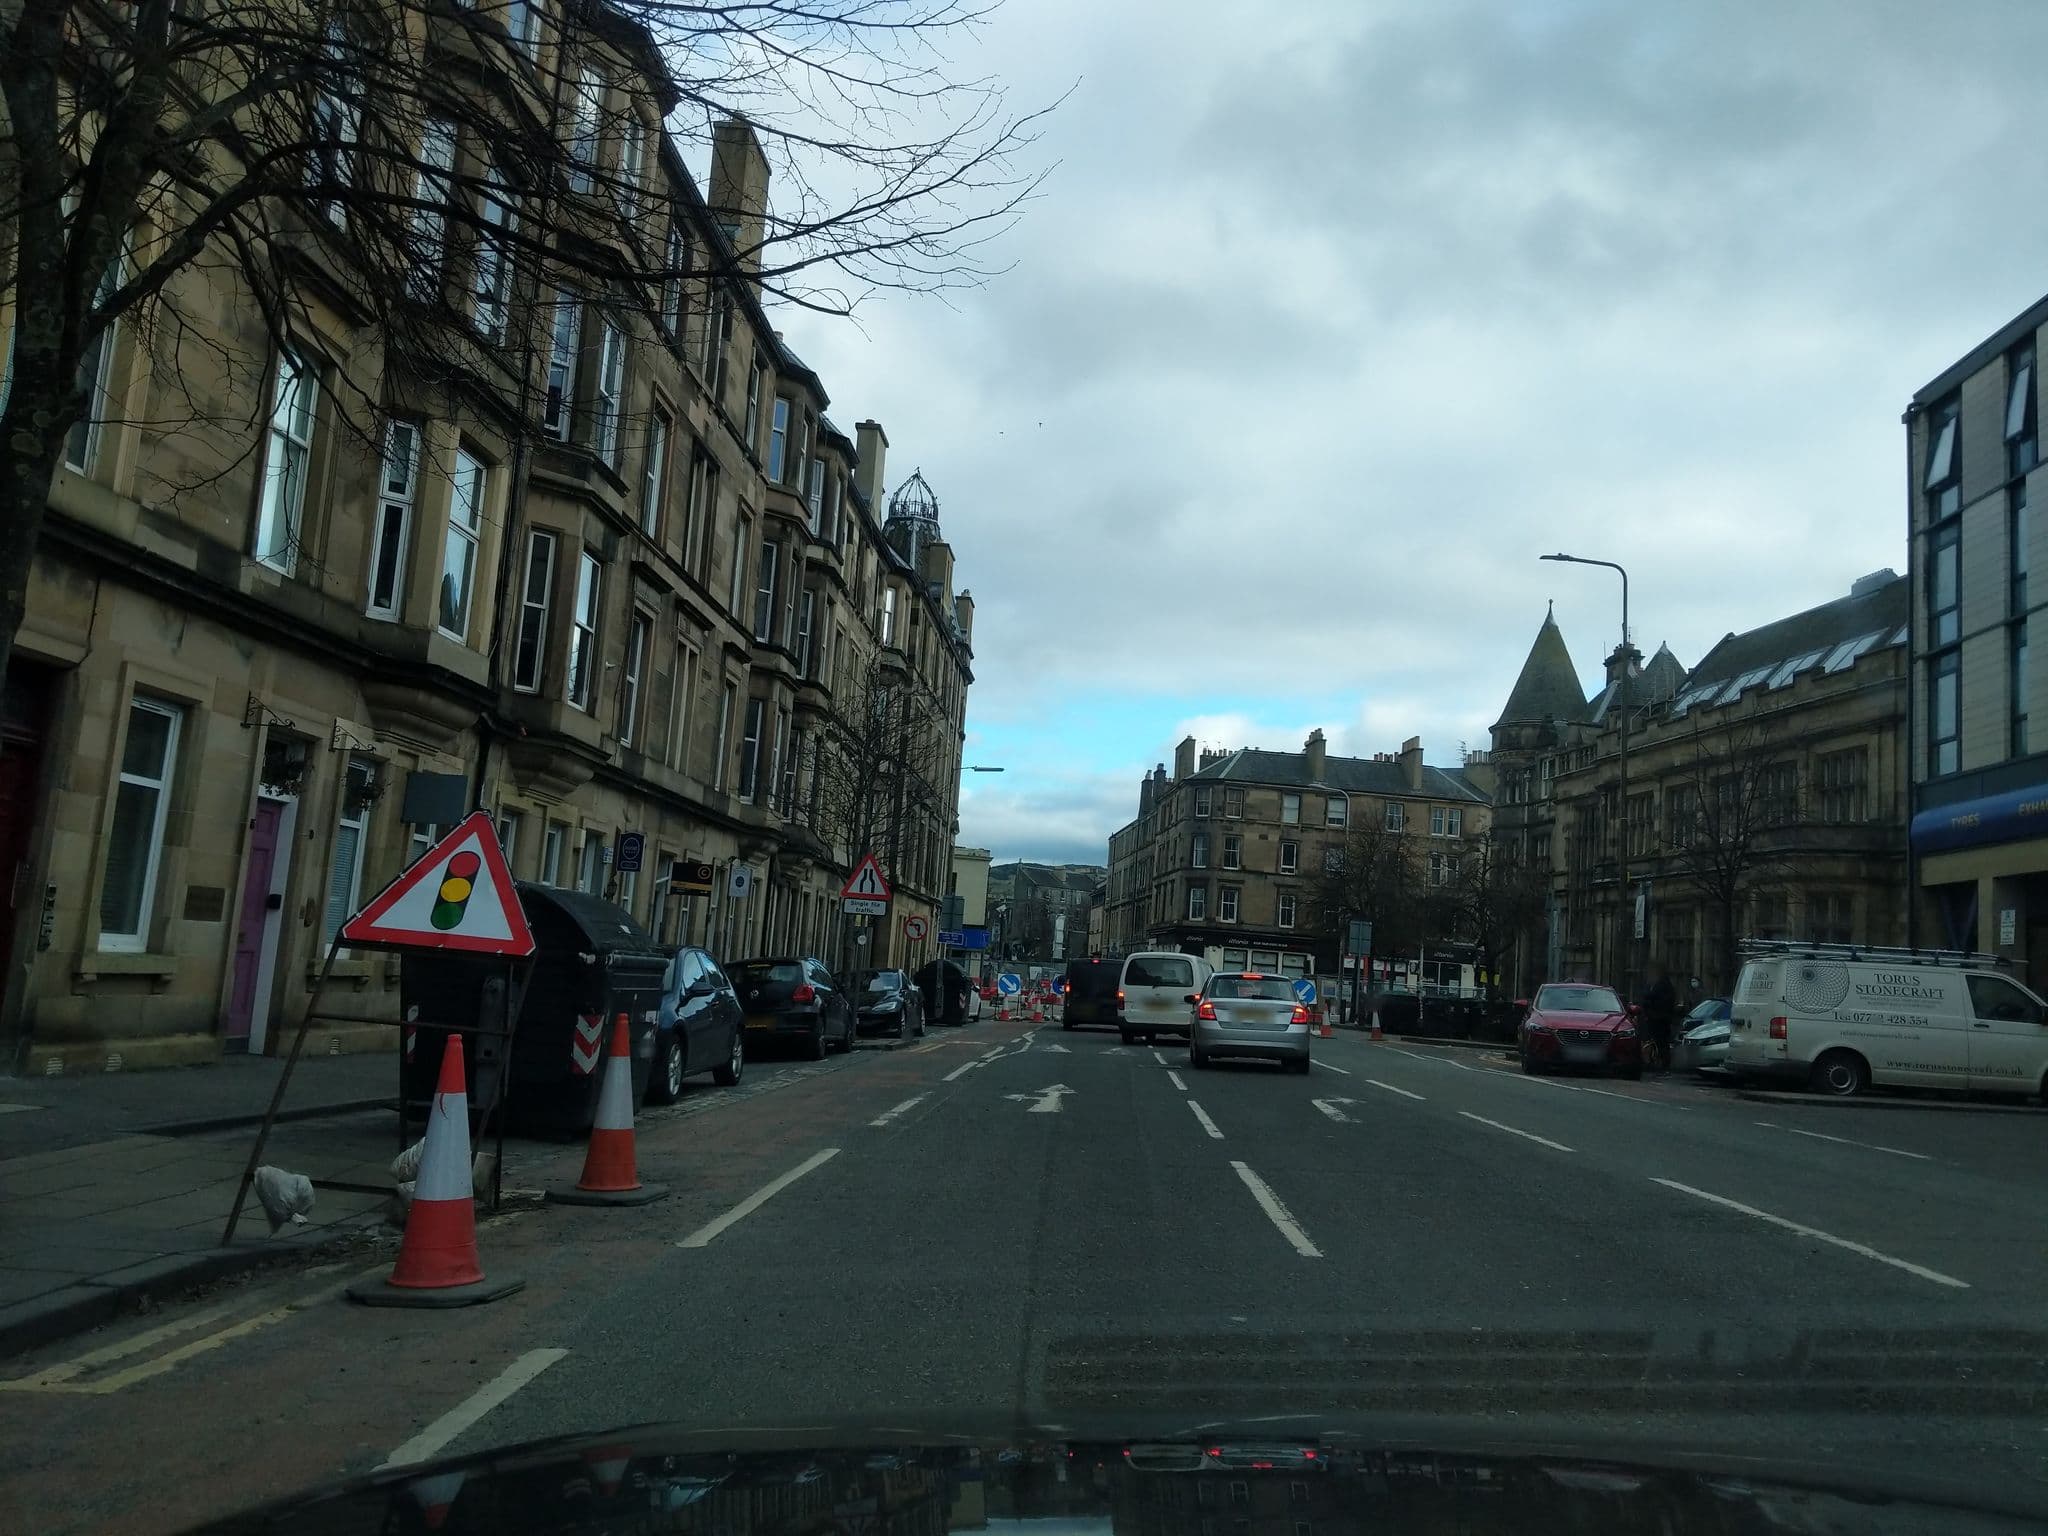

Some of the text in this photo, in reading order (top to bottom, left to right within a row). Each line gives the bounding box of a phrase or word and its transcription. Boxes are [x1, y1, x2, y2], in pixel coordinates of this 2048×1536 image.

[1951, 800, 2048, 830] TYRES EXHA
[1873, 973, 1921, 986] TORUS
[1855, 984, 1944, 998] STONECRAFT
[1887, 1015, 1907, 1024] 428
